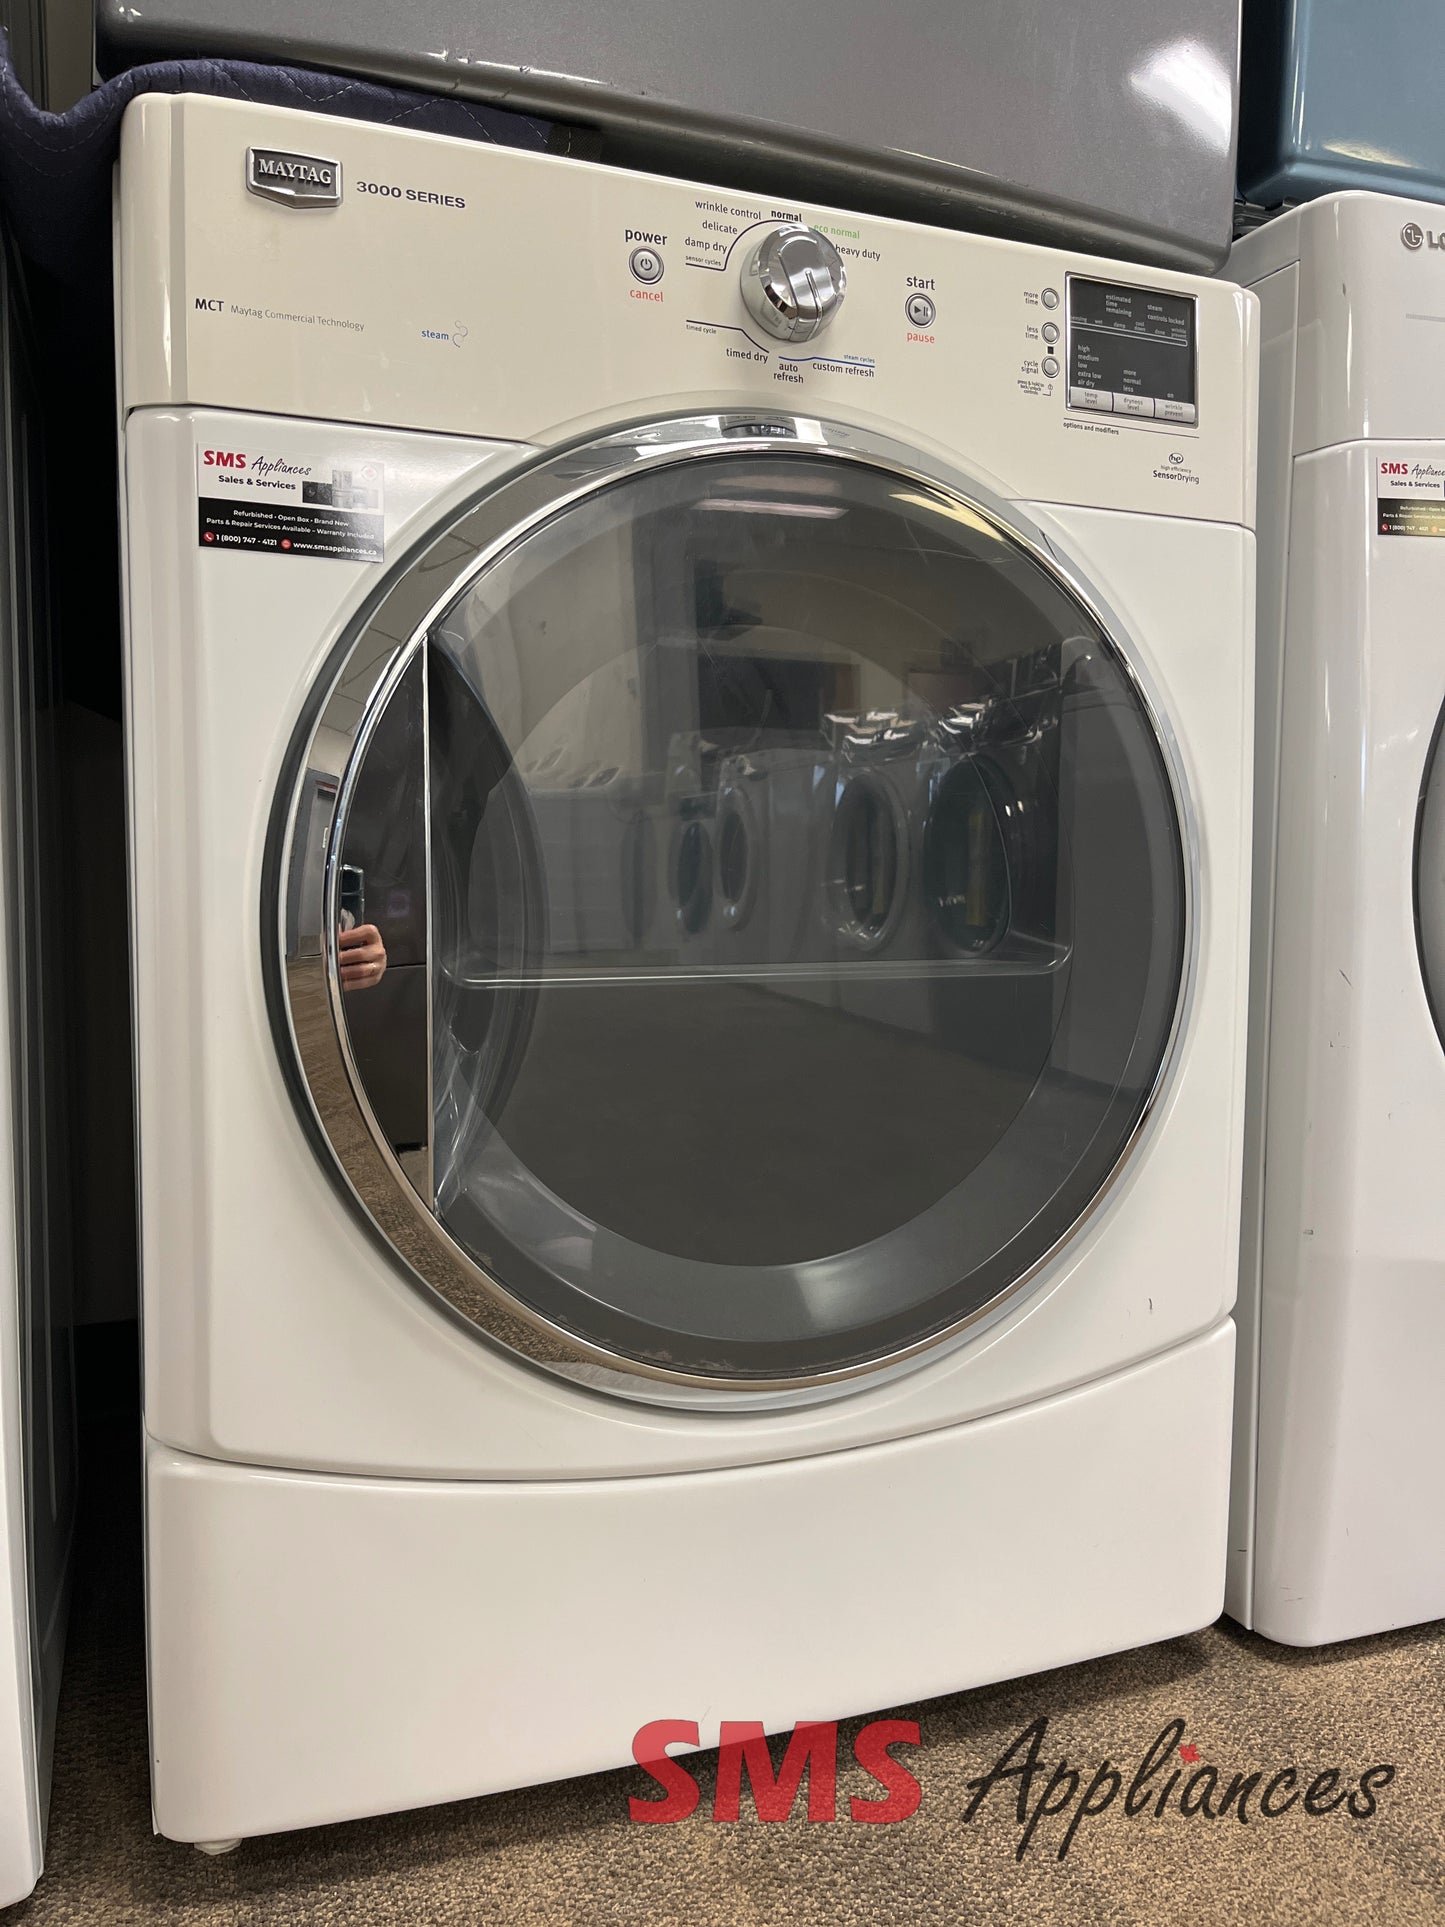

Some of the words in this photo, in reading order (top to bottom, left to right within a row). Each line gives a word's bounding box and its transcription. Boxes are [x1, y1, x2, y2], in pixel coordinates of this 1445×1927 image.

[258, 158, 333, 185] MAYTAG
[356, 180, 402, 198] 3000
[406, 188, 466, 209] SERIES
[695, 201, 728, 214] wrinkle
[730, 208, 761, 220] control
[771, 210, 802, 222] normal
[702, 220, 738, 234] delicate
[813, 224, 828, 233] eco
[831, 227, 860, 238] normal
[624, 228, 668, 247] power
[685, 237, 710, 250] damp
[712, 242, 728, 254] dry
[836, 244, 860, 258] heavy
[862, 249, 880, 261] duty
[704, 257, 722, 266] cycles
[906, 276, 936, 290] start
[630, 288, 664, 302] cancel
[1024, 291, 1038, 299] more
[1106, 294, 1132, 304] estimated
[195, 298, 224, 312] MCT
[230, 304, 263, 318] Maytag
[264, 310, 316, 324] Commercial
[318, 316, 364, 332] Technology
[1106, 307, 1132, 318] remaining
[1147, 314, 1168, 322] controls
[1168, 317, 1184, 326] locked
[420, 328, 449, 341] steam
[686, 324, 702, 332] timed
[702, 327, 716, 335] cycle
[1026, 325, 1038, 334] less
[1026, 332, 1038, 340] time
[907, 332, 934, 344] pause
[1078, 344, 1090, 353] high
[726, 348, 752, 360] timed
[754, 352, 768, 364] dry
[1078, 354, 1099, 362] medium
[778, 364, 798, 372] auto
[812, 362, 842, 374] custom
[845, 366, 874, 378] refresh
[1021, 366, 1038, 374] signal
[1024, 360, 1038, 368] cycle
[774, 372, 804, 384] refresh
[1086, 380, 1094, 388] dry
[1084, 392, 1098, 400] temp
[1063, 421, 1083, 430] options
[1084, 424, 1094, 432] and
[1095, 426, 1120, 435] modifiers
[204, 450, 246, 469] SMS
[251, 455, 312, 476] Appliances
[1152, 470, 1200, 484] SensorDrying
[1381, 462, 1408, 474] SMS
[1411, 464, 1445, 479] Appliance
[218, 474, 244, 484] Sales
[256, 479, 296, 490] Services
[234, 510, 273, 520] Refurbished
[278, 514, 296, 523] Open
[314, 518, 334, 526] Brand
[232, 520, 252, 528] Repair
[254, 522, 280, 530] Services
[282, 524, 310, 534] Available
[316, 528, 346, 538] Warranty
[347, 531, 375, 540] Included
[221, 534, 241, 544] (800)
[243, 536, 256, 544] 747
[262, 538, 277, 546] 4121
[294, 542, 377, 556] www.smsappliances.ca
